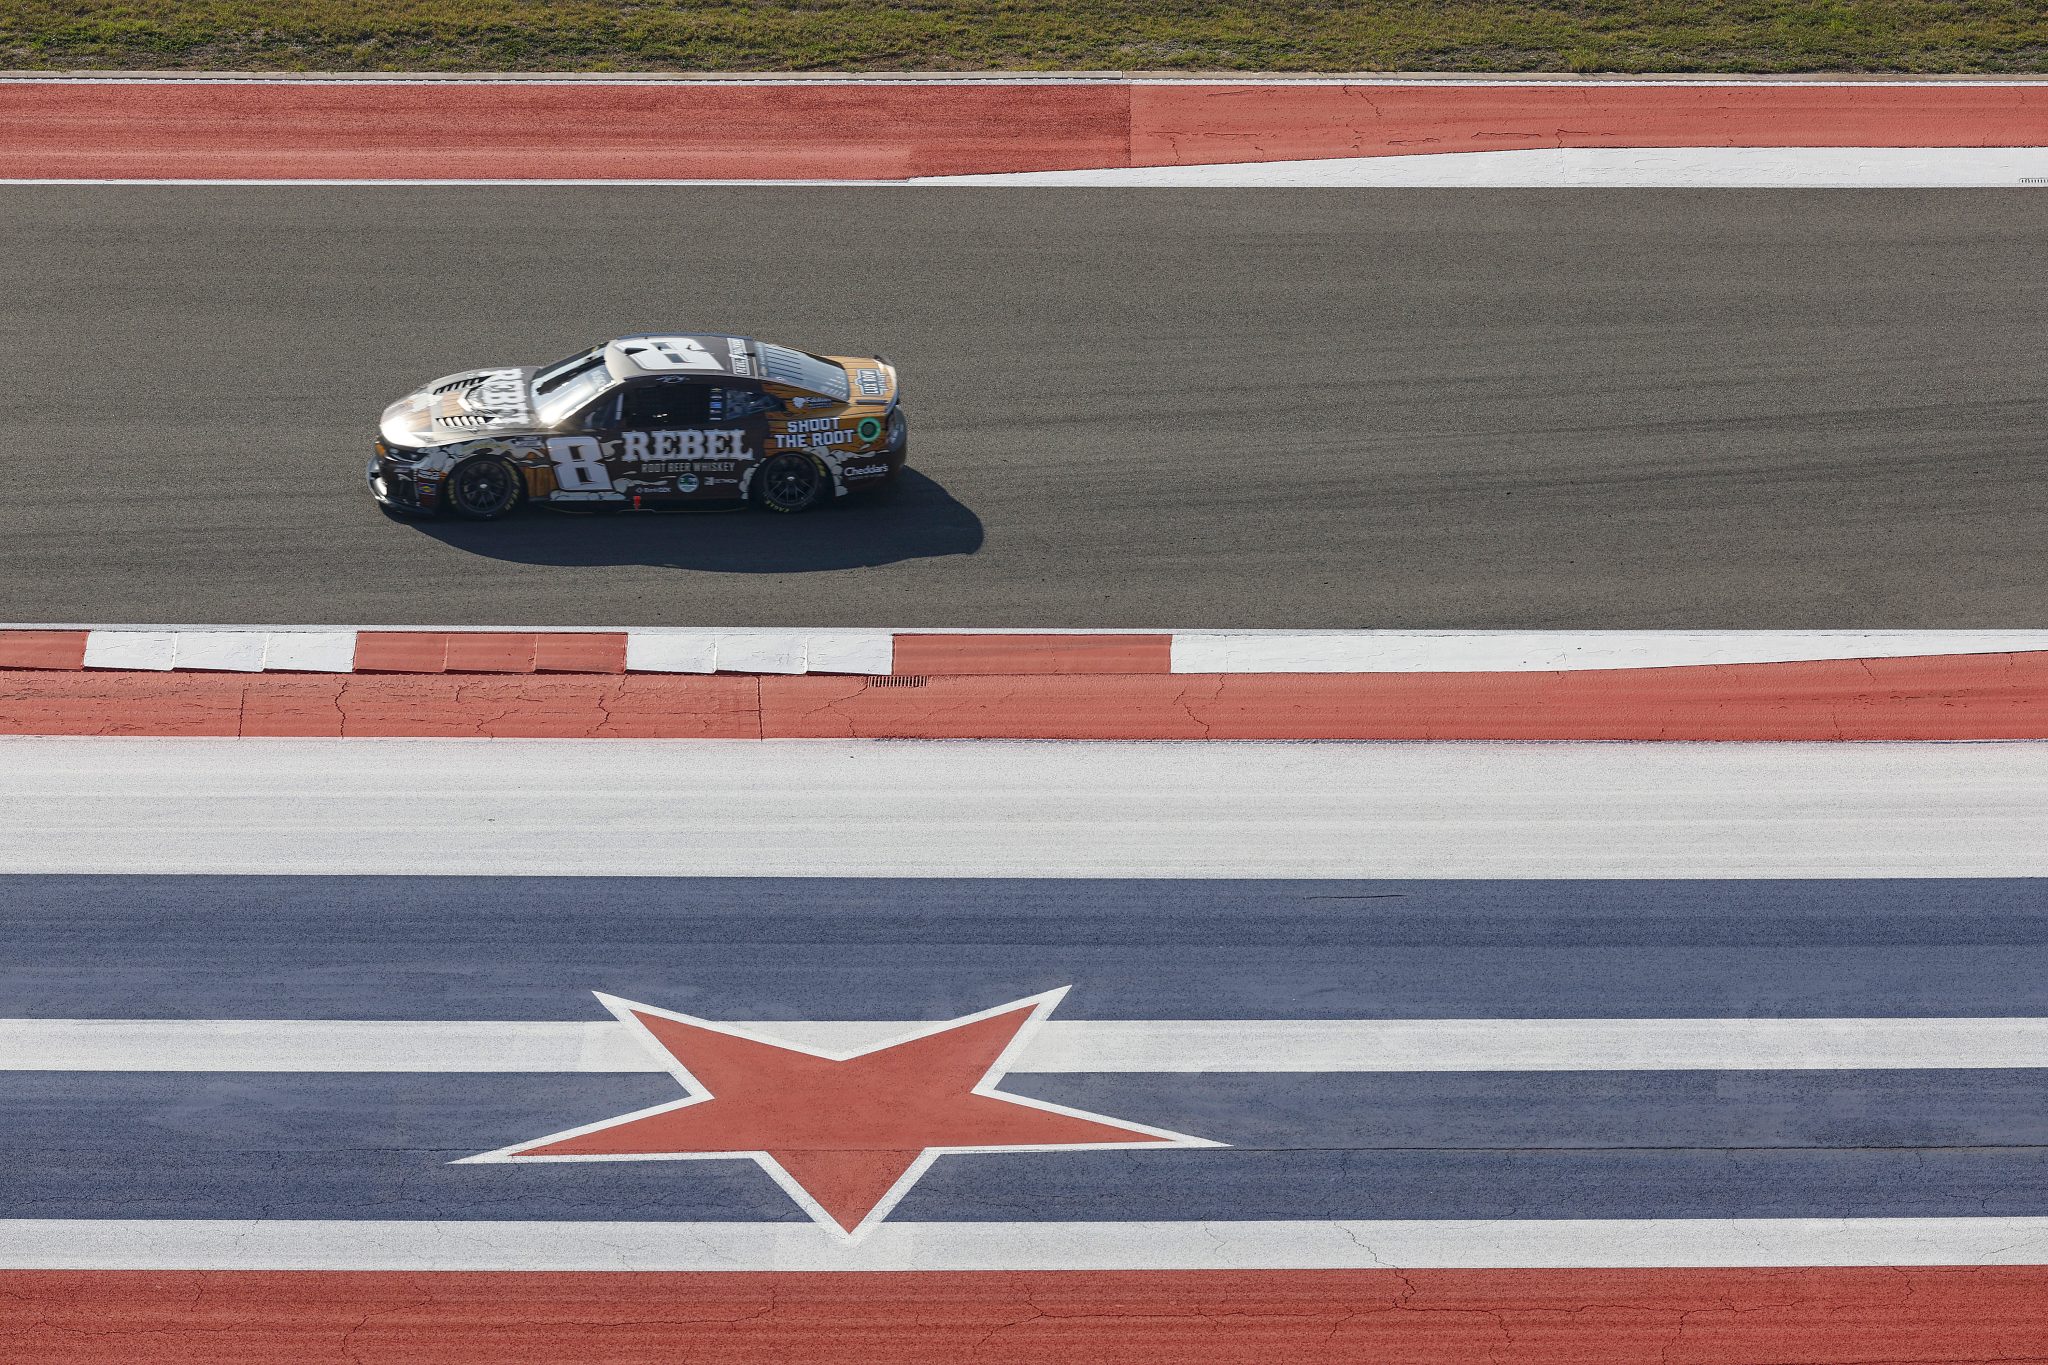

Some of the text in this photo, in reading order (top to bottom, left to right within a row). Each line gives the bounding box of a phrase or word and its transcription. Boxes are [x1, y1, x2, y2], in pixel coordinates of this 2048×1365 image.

[479, 368, 531, 425] REBEL
[787, 418, 840, 433] SHOOT
[621, 428, 753, 461] REBEL
[774, 429, 855, 449] THE ROOT
[546, 436, 615, 492] 8
[641, 462, 735, 473] ROOT BEER WHISKEY
[843, 464, 889, 477] Cheddar's
